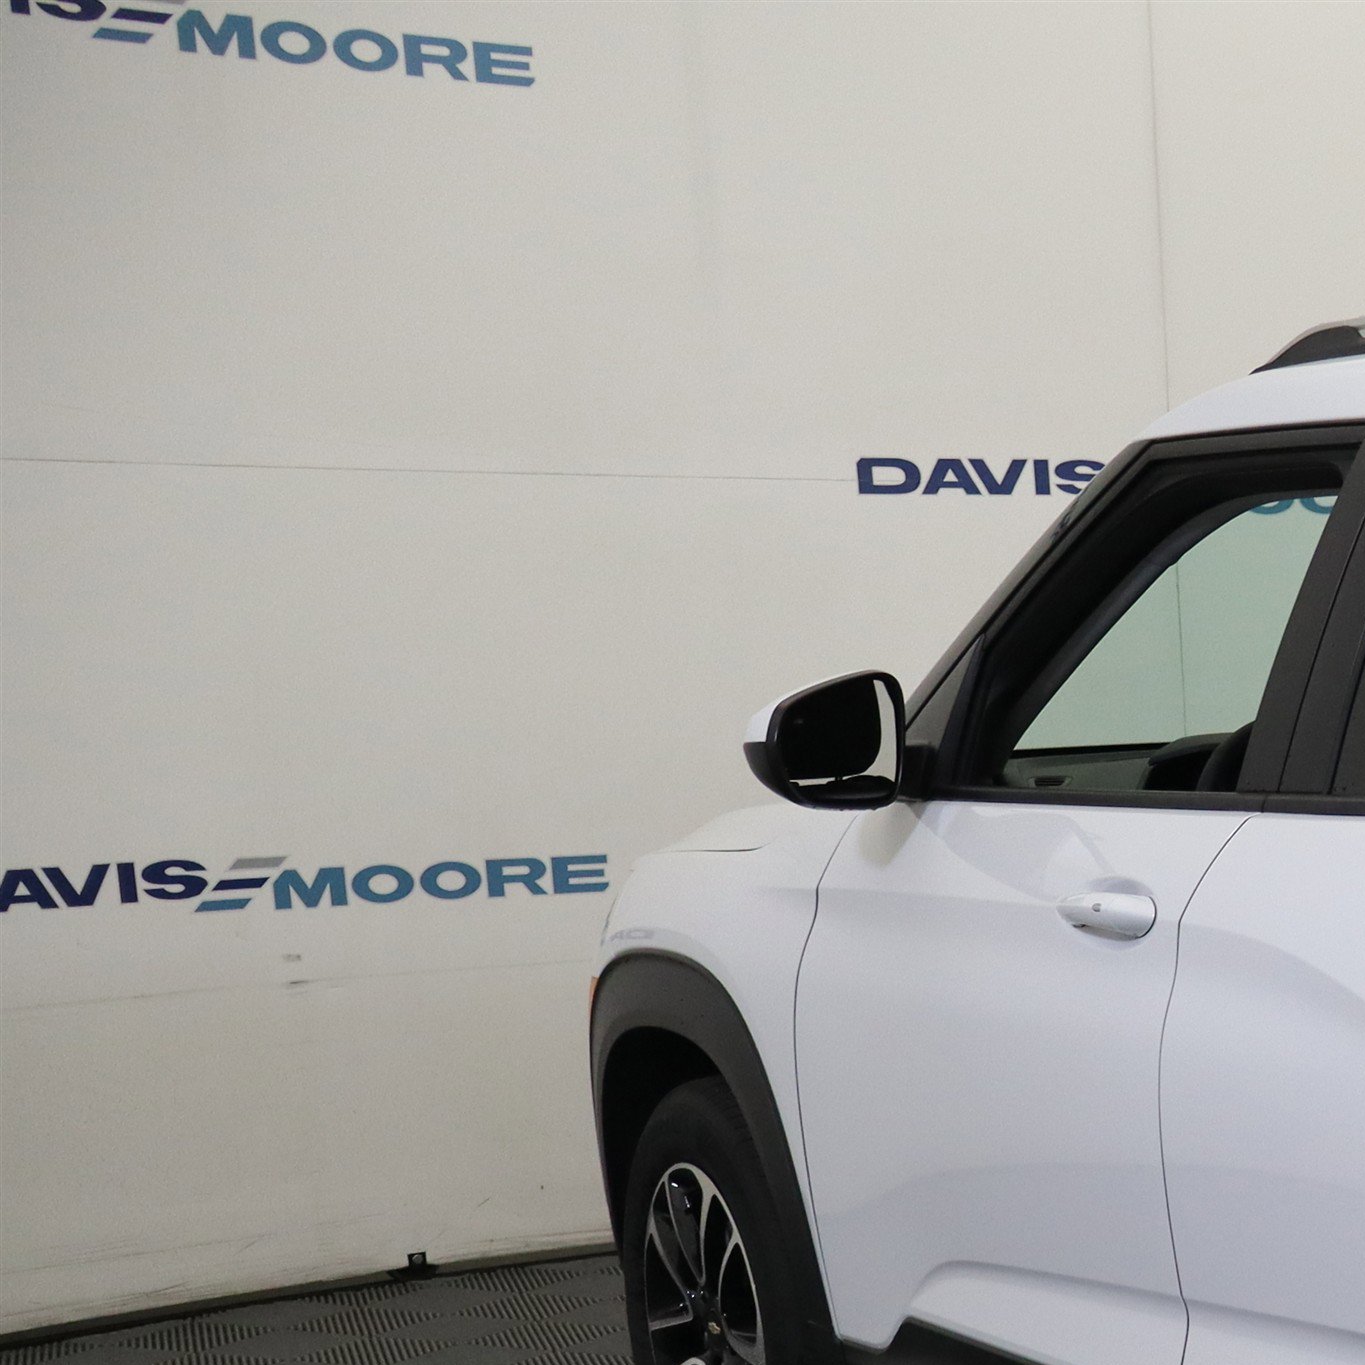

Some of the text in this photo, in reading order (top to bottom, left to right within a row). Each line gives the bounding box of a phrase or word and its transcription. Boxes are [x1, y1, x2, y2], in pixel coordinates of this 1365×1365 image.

[176, 9, 536, 88] MOORE
[856, 457, 1106, 496] DAVIS
[272, 854, 609, 910] MOORE
